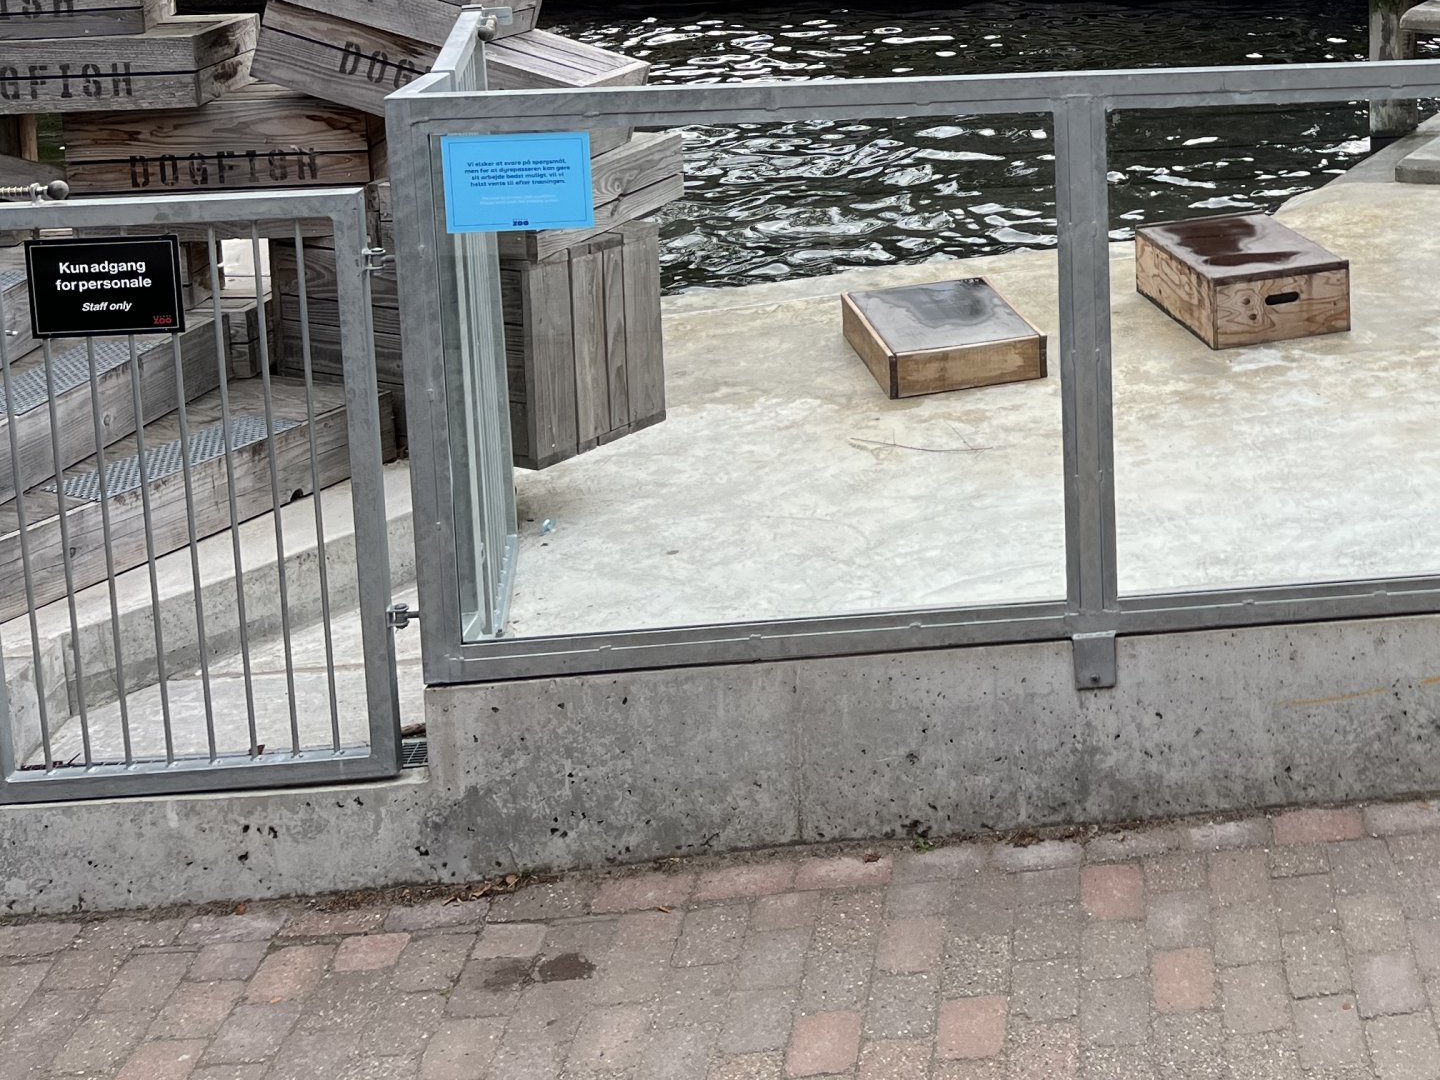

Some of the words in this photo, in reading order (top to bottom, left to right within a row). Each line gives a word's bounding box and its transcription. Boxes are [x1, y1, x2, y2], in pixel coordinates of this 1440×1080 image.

[129, 148, 318, 187] DOGFISH
[59, 262, 88, 274] Kun
[90, 261, 146, 274] adgang
[56, 279, 78, 290] for
[79, 276, 152, 292] personale
[82, 302, 108, 311] Staff
[109, 301, 132, 311] only
